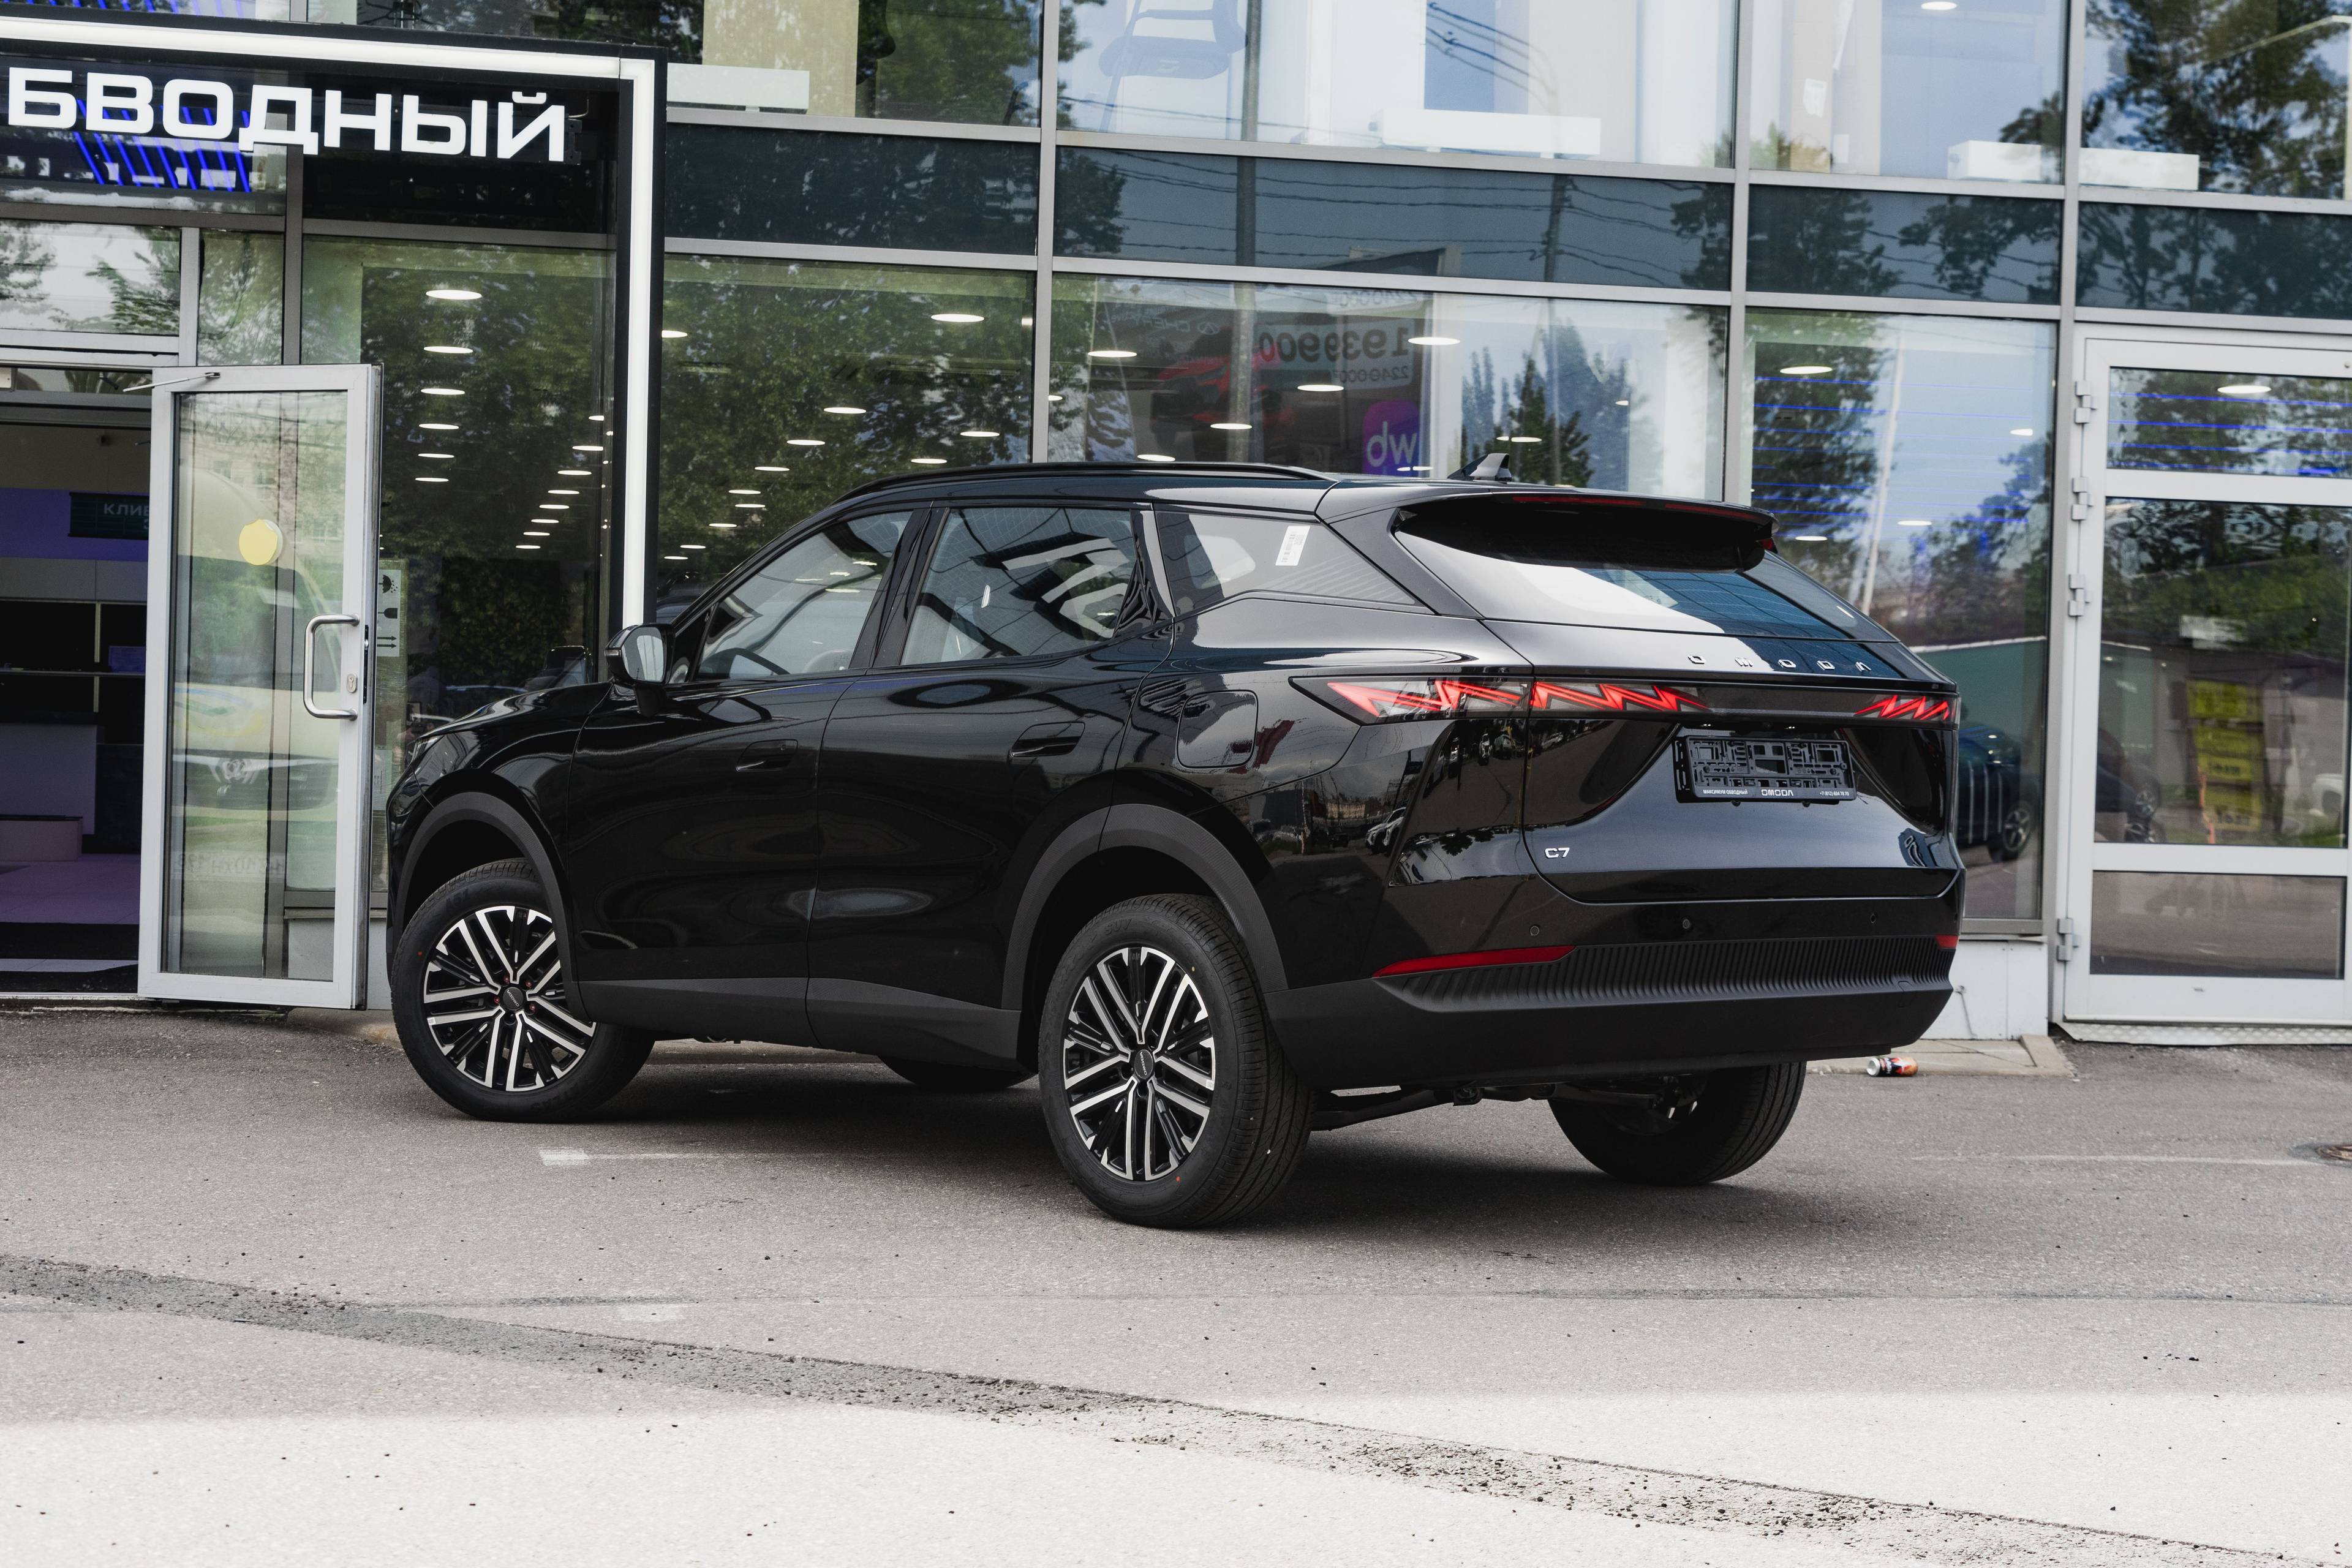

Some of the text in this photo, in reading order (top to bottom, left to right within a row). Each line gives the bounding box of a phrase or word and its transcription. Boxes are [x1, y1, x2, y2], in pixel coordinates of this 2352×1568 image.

[9, 67, 565, 162] БВОДНЫЙ
[1687, 655, 1871, 671] OMODA
[1545, 847, 1570, 858] C7
[1104, 918, 1133, 936] SUV
